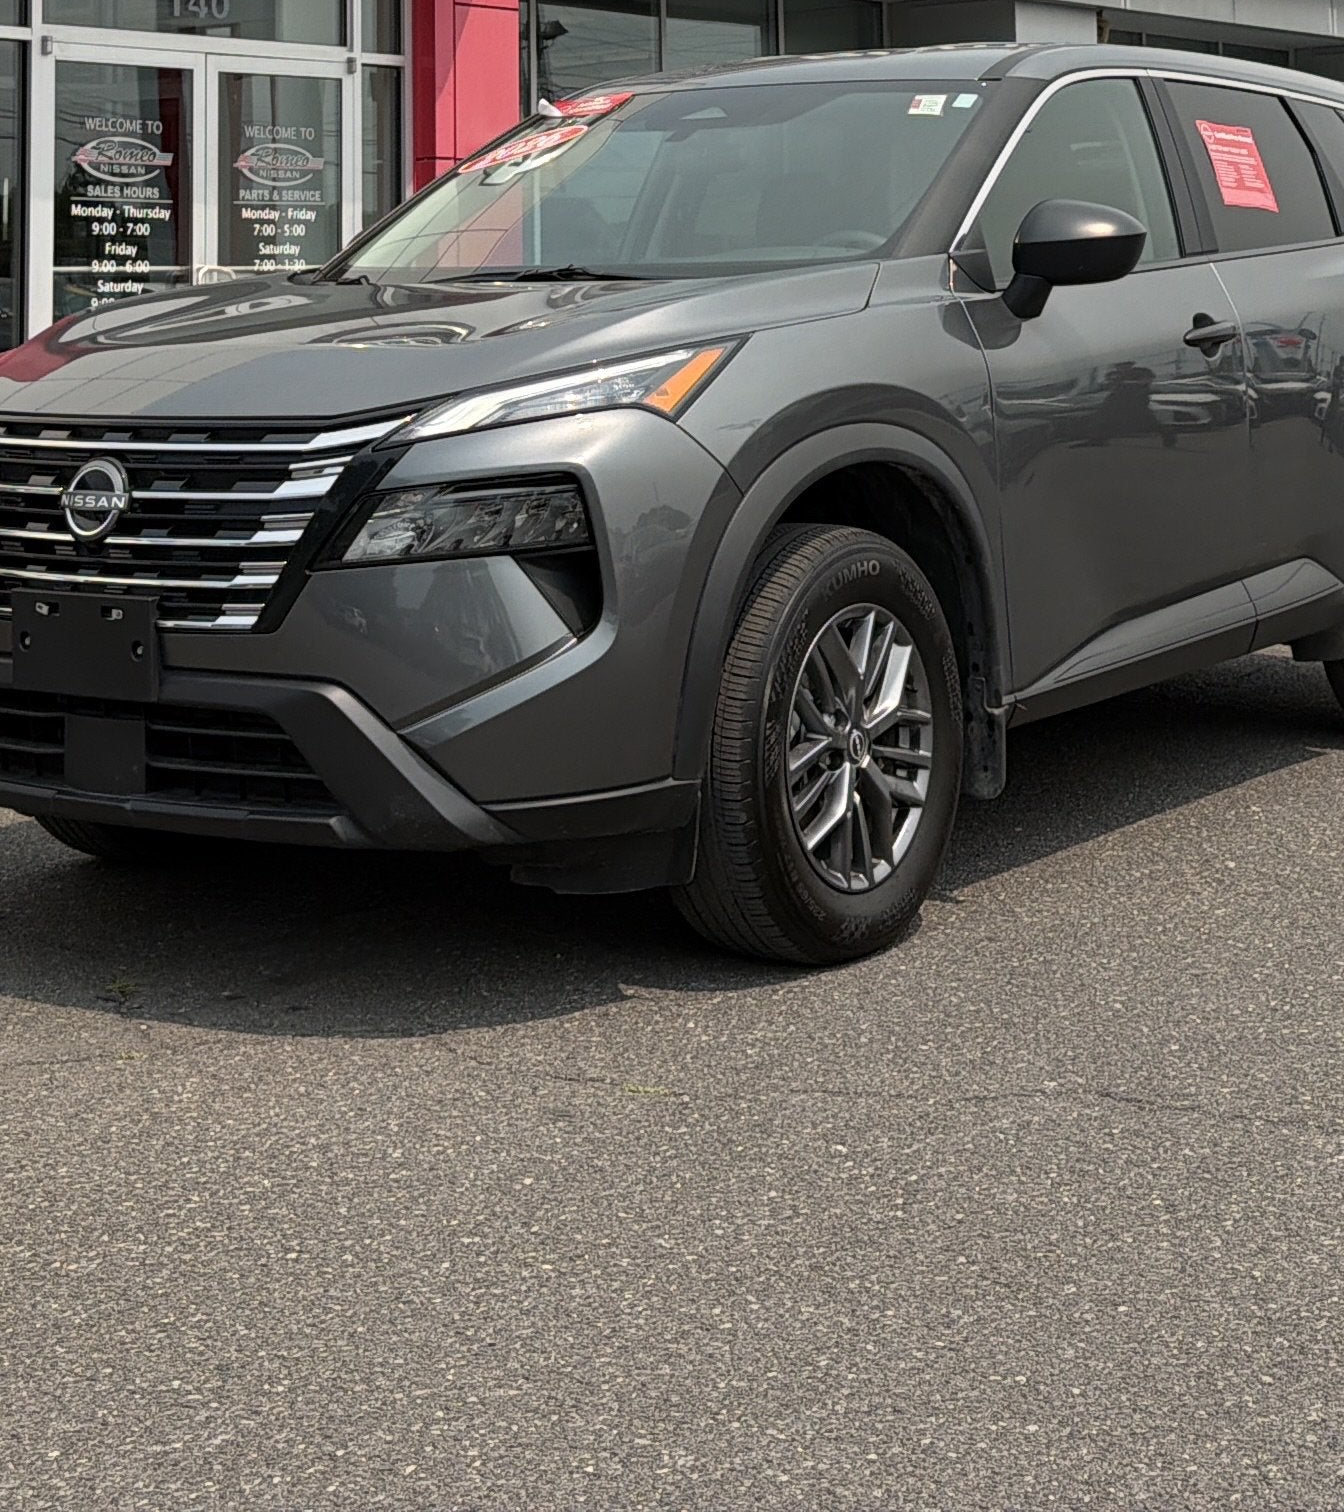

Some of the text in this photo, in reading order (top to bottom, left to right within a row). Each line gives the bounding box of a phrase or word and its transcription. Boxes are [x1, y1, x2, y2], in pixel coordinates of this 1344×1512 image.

[84, 117, 163, 135] WELCOME TO
[244, 125, 315, 139] WELCOME TO
[94, 140, 157, 163] Romeo
[254, 148, 310, 167] Romeo
[100, 164, 146, 174] NISSAN
[259, 169, 300, 178] NISSAN
[86, 185, 160, 199] SALES HOURS
[239, 190, 321, 201] PARTS & SERVICE
[71, 204, 114, 220] Monday
[122, 205, 171, 221] Thursday
[241, 207, 280, 221] Monday
[288, 207, 317, 222] Friday
[91, 222, 117, 235] 9:00
[126, 223, 150, 236] 7:00
[253, 224, 275, 236] 7:00
[284, 224, 305, 236] 5:00
[105, 242, 138, 257] Friday
[259, 242, 301, 256] Saturday
[91, 260, 116, 273] 9:00
[125, 260, 150, 273] 6:00
[253, 259, 276, 271] 7:00
[97, 280, 144, 295] Saturday
[61, 494, 125, 508] NISSAN
[821, 559, 880, 600] KUMHO
